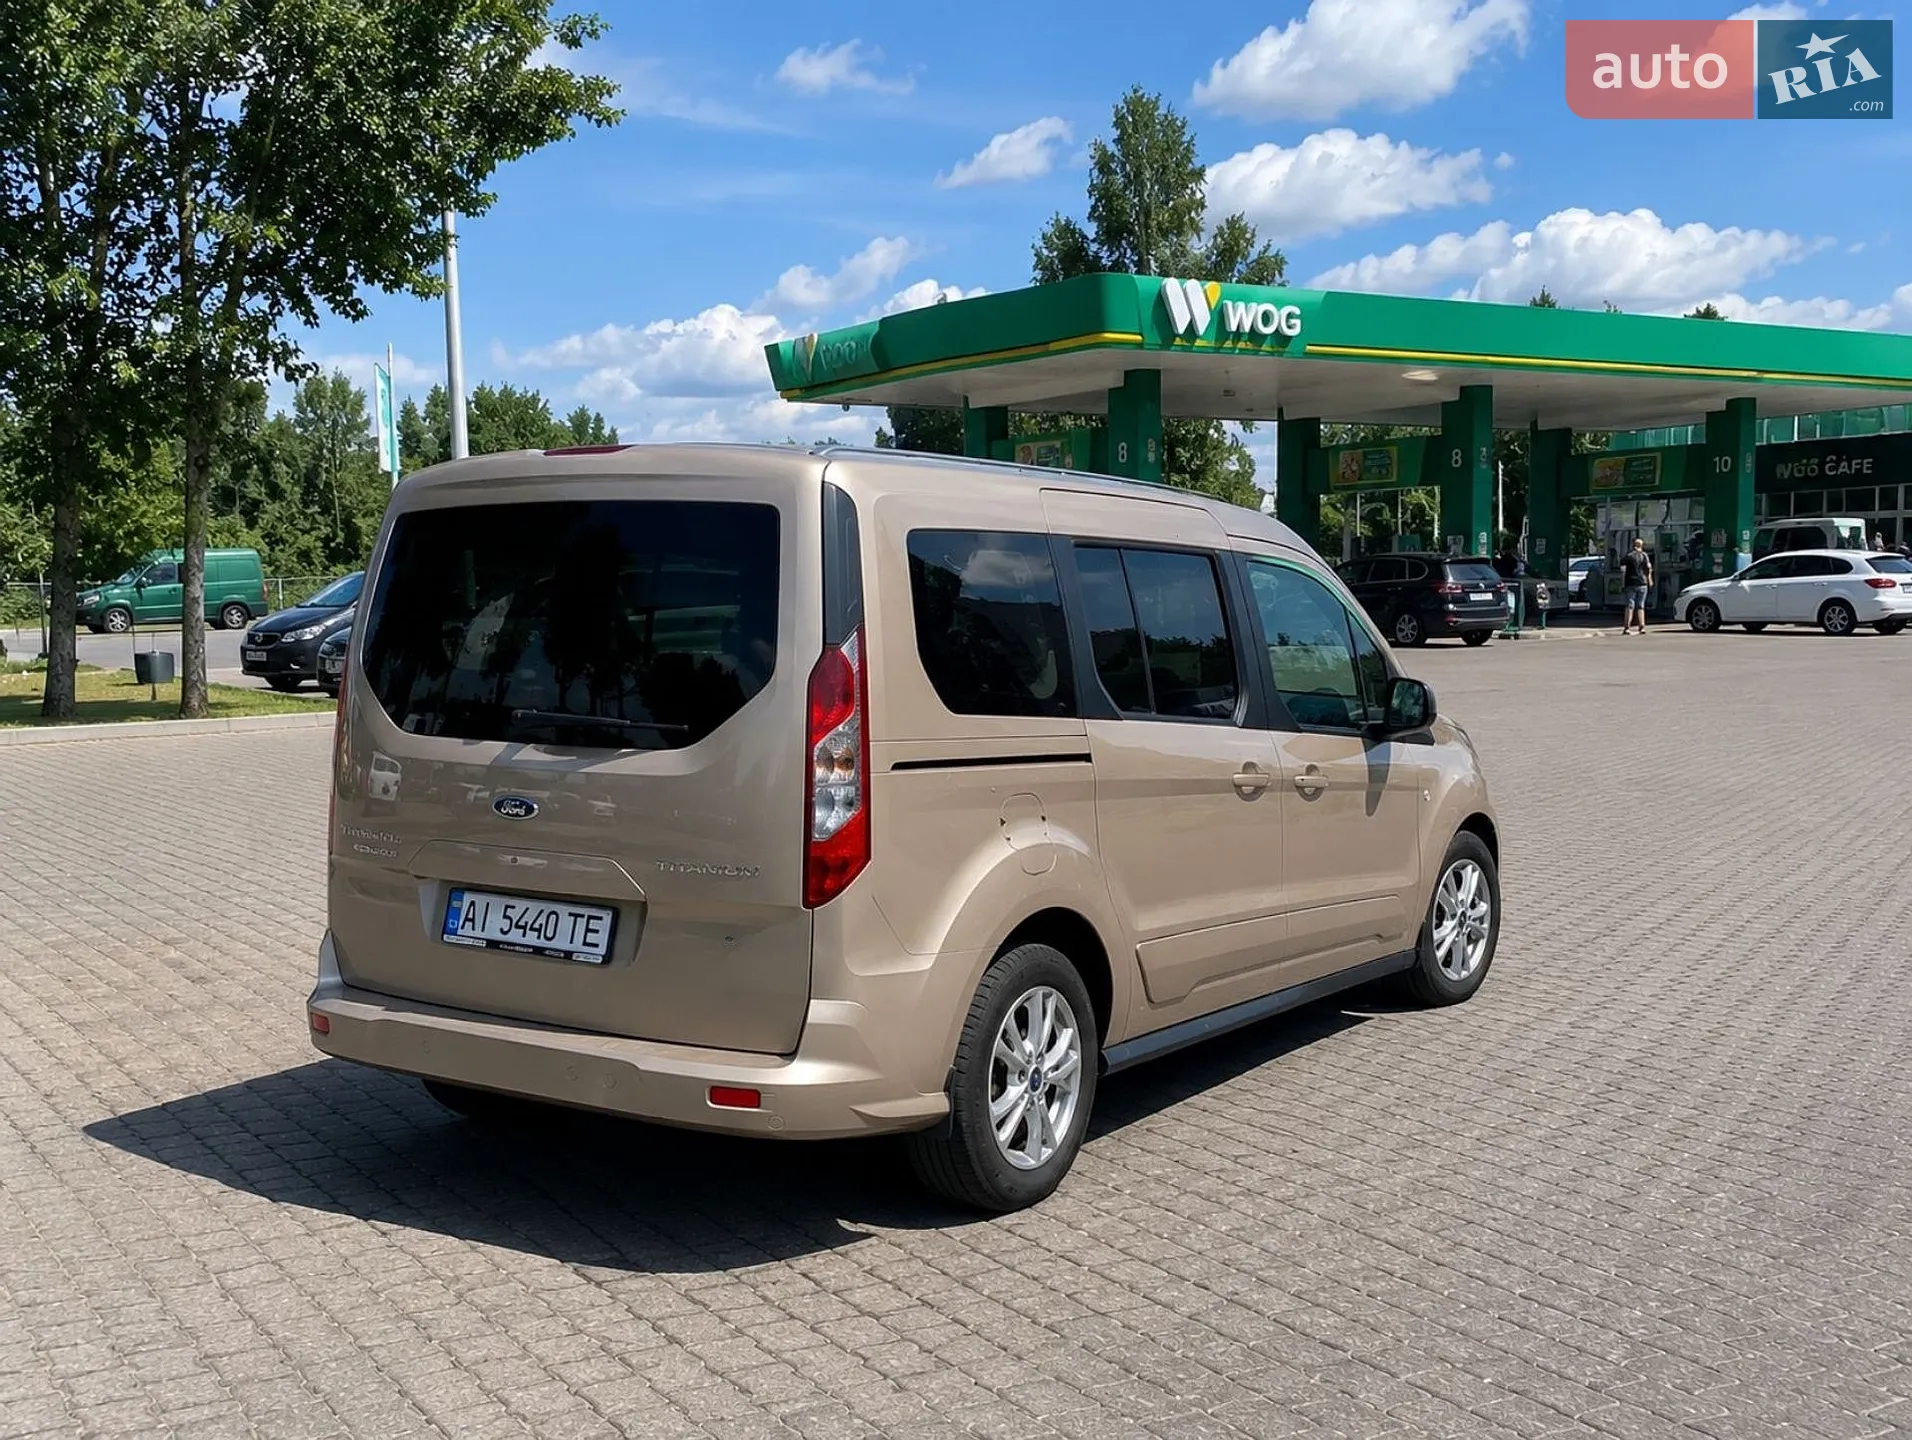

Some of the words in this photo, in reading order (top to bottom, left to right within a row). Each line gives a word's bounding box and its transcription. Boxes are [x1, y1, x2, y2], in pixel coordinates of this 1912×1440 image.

[1223, 300, 1301, 337] WOG
[1118, 441, 1128, 463] 8
[1451, 448, 1462, 468] 8
[1713, 456, 1731, 473] 10
[500, 904, 559, 941] 5440
[568, 912, 603, 948] TE
